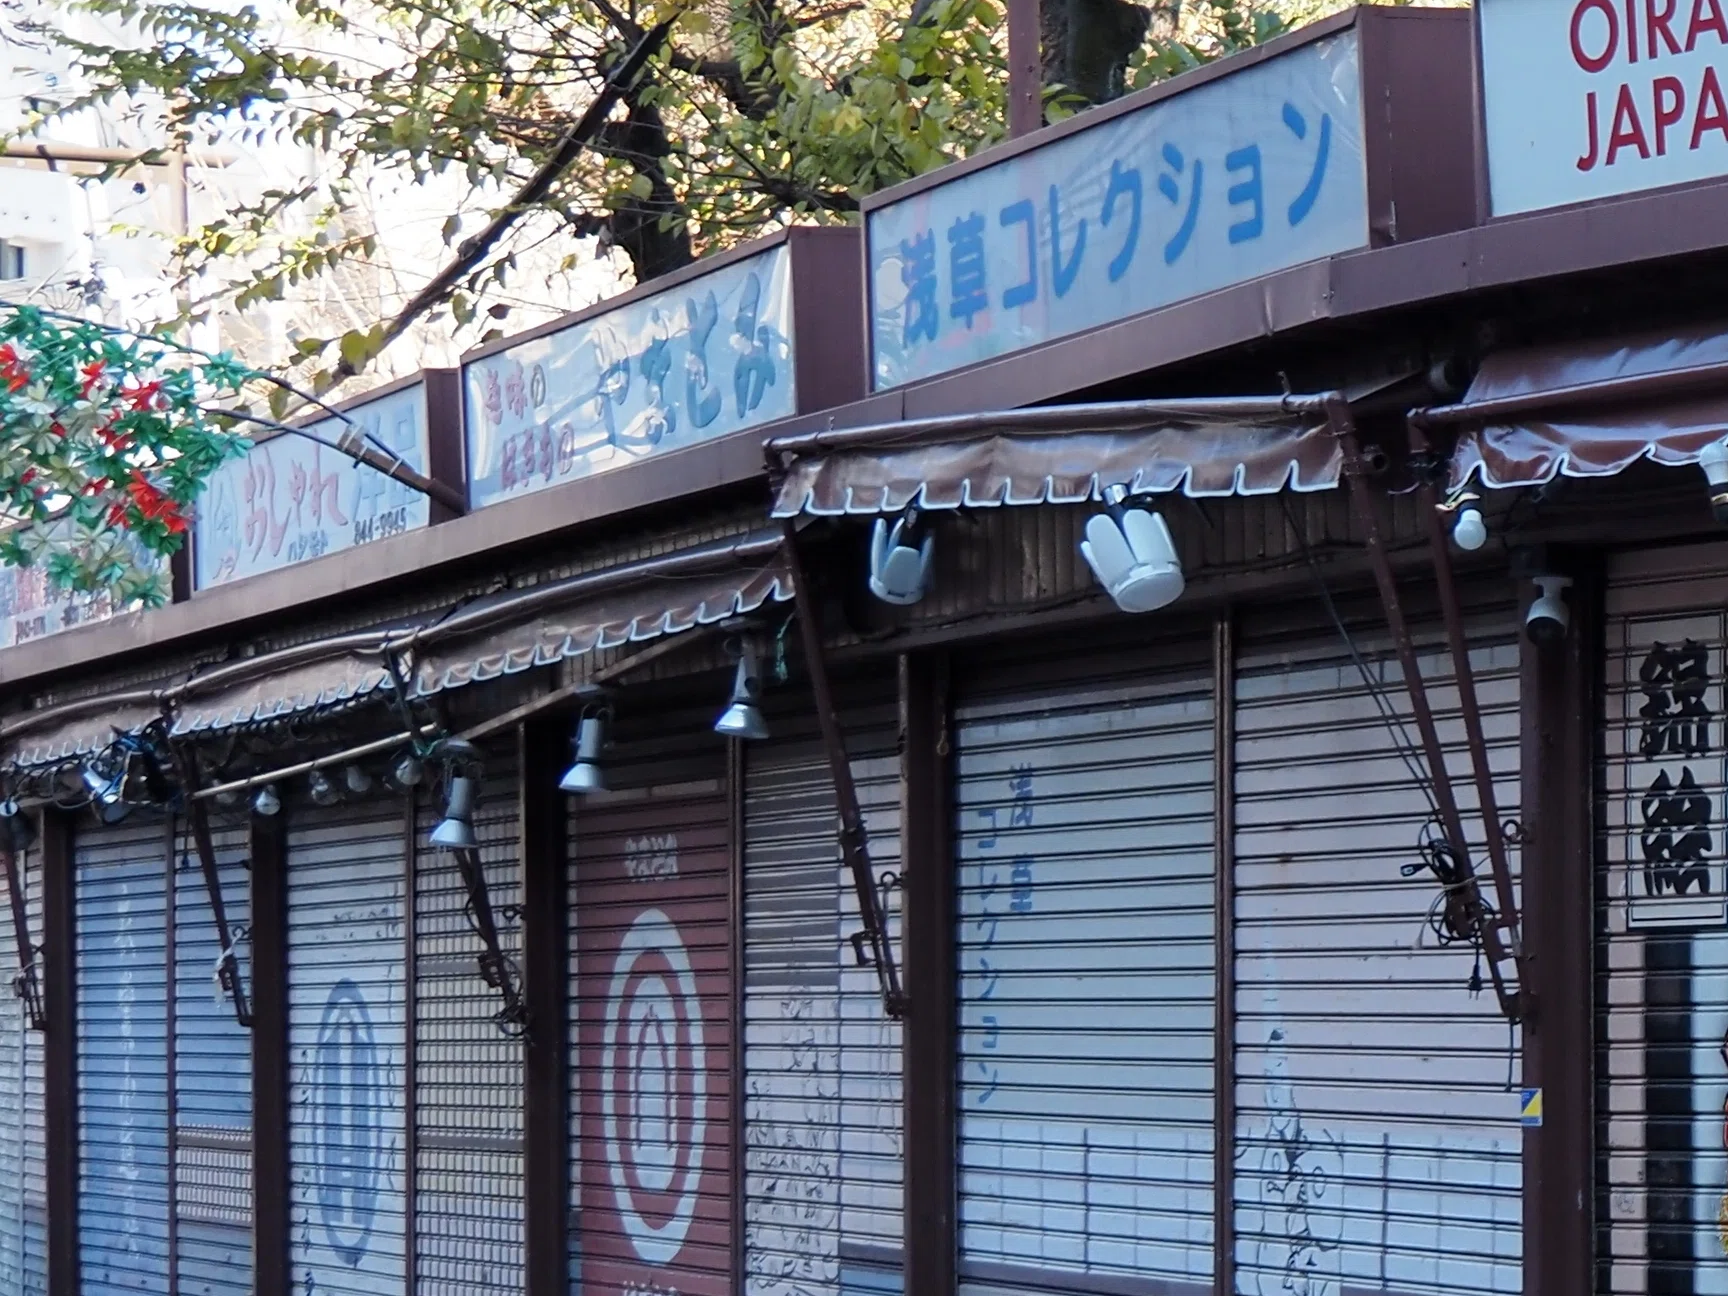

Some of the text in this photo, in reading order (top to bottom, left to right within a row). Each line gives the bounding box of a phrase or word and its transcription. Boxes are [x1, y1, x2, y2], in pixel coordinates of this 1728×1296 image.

[901, 101, 1332, 347] 浅草コレクション
